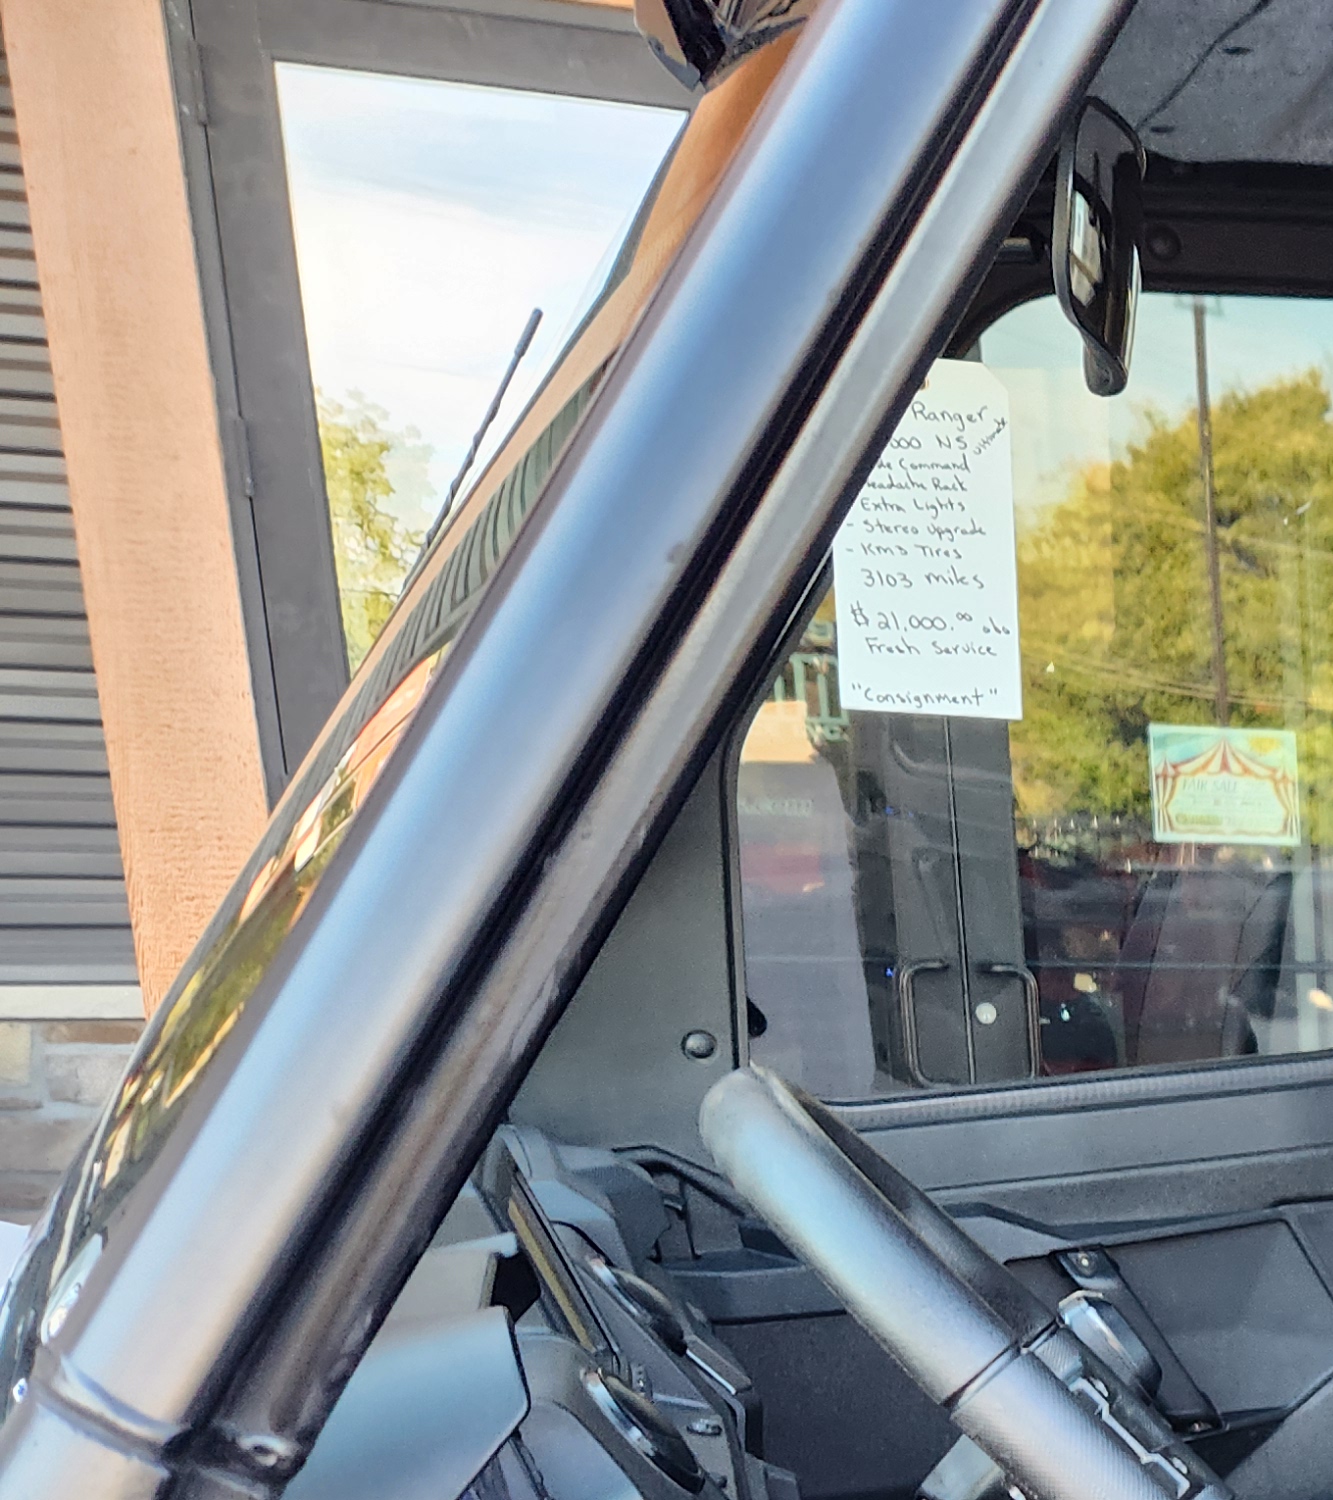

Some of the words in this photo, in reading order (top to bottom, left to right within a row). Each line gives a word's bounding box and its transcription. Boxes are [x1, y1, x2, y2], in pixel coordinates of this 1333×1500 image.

[911, 400, 988, 432] Ranger
[889, 434, 922, 450] 000
[898, 453, 972, 474] Command
[866, 472, 928, 491] eadache
[931, 474, 968, 492] Rack
[860, 496, 907, 514] Extra
[913, 497, 966, 520] Lights
[862, 518, 919, 535] Stereo
[860, 567, 914, 588] 3103
[864, 635, 921, 655] Fresh
[931, 639, 998, 657] Service
